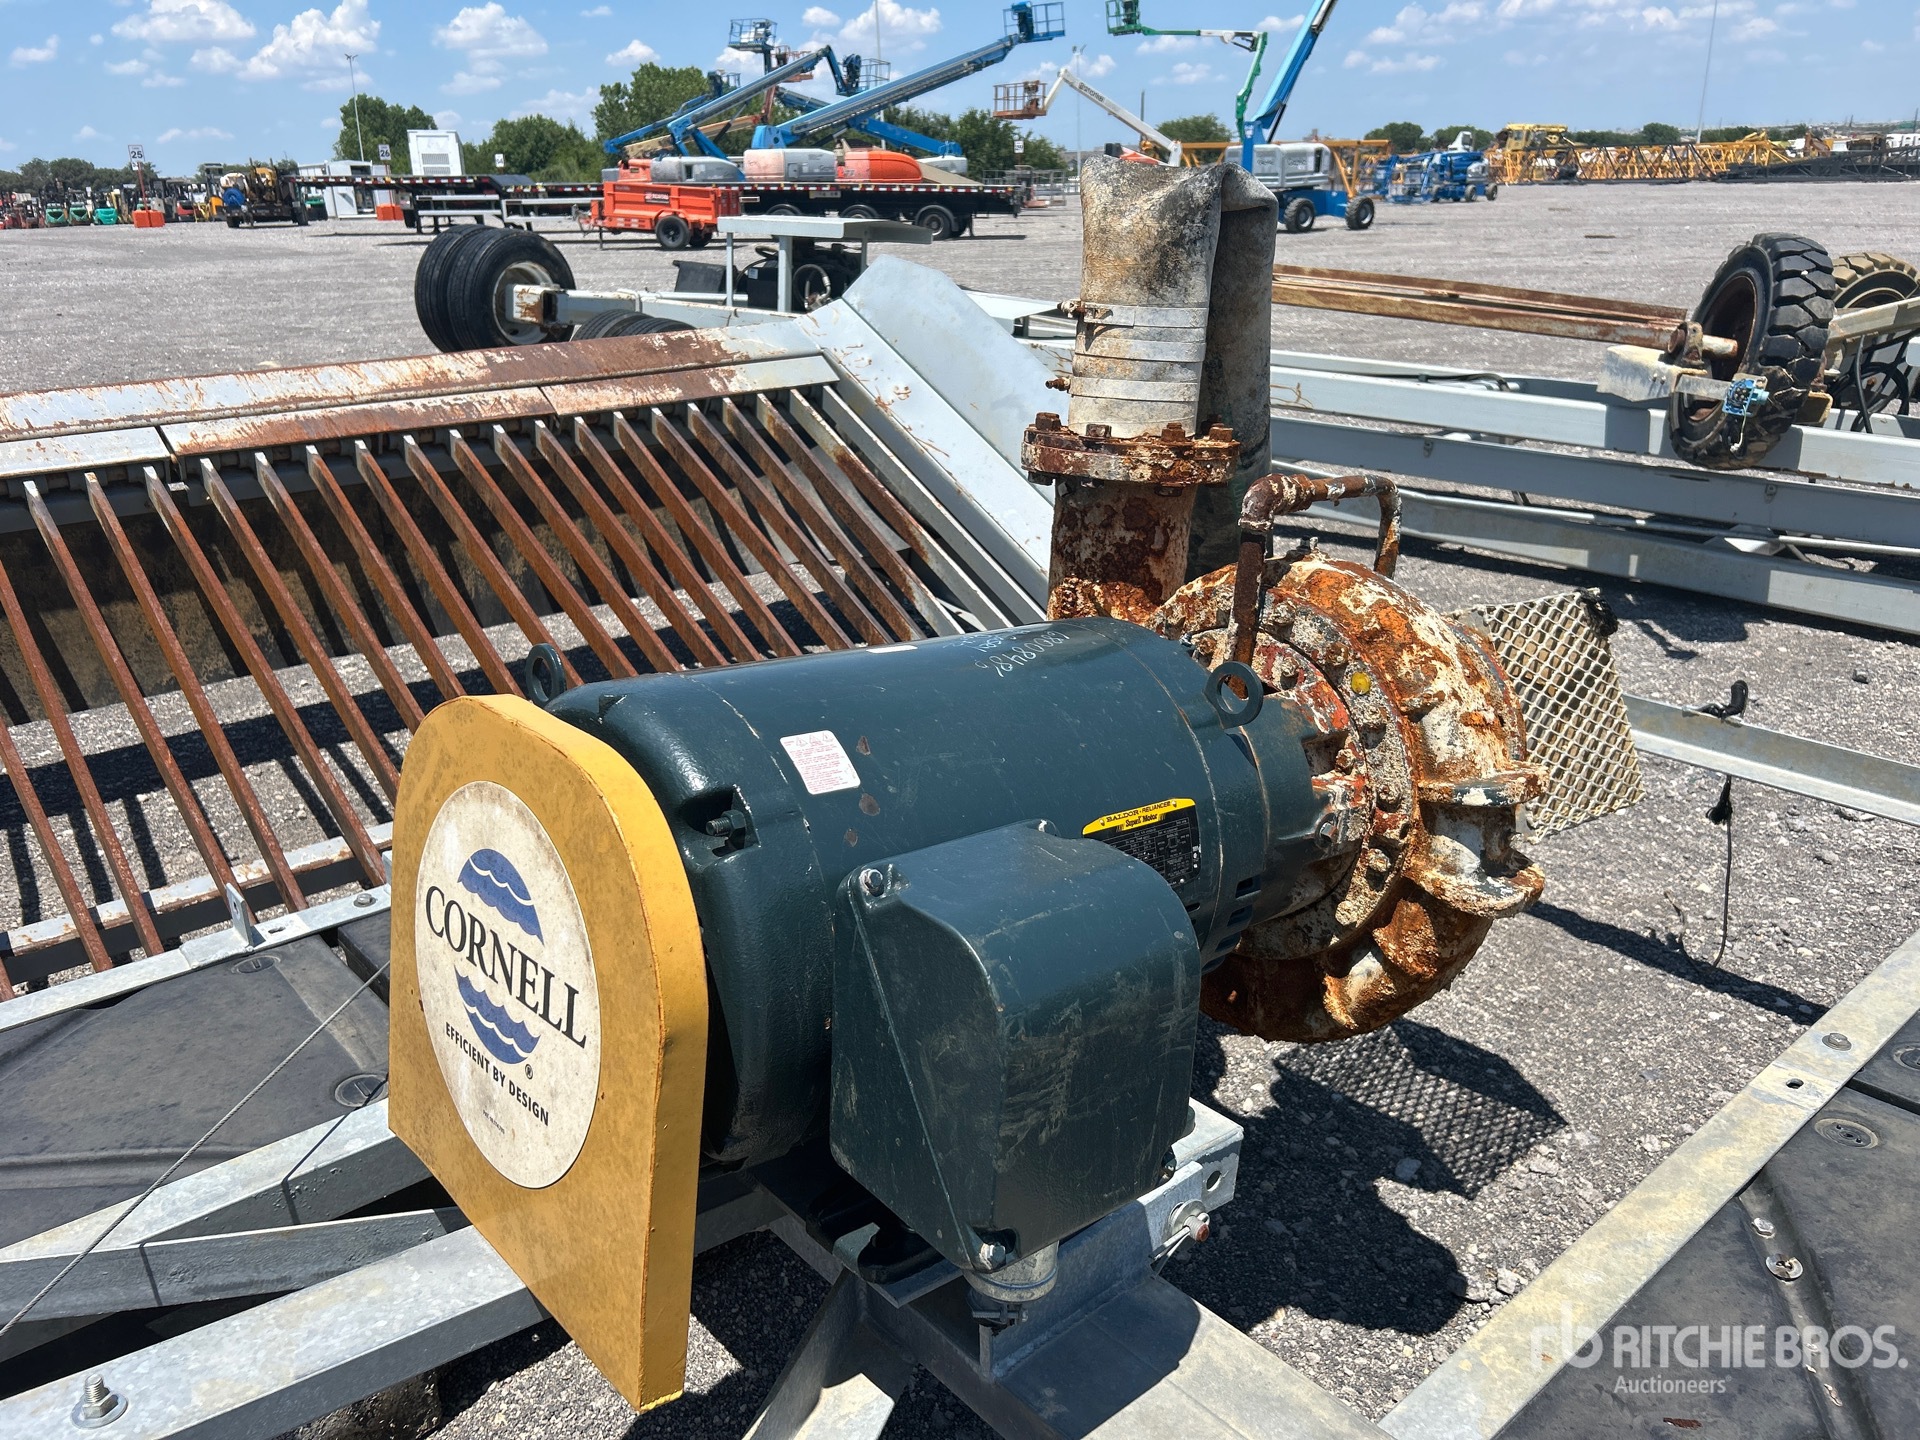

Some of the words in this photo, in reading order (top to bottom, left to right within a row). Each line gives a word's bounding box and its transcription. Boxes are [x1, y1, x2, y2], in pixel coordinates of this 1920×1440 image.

[130, 151, 143, 159] 25
[1106, 809, 1140, 823] BALDOR
[1142, 813, 1158, 823] Motor
[426, 885, 587, 1049] CORNELL
[445, 1021, 490, 1074] EFFICIENT
[492, 1065, 506, 1088] BY
[508, 1079, 549, 1127] DESIGN
